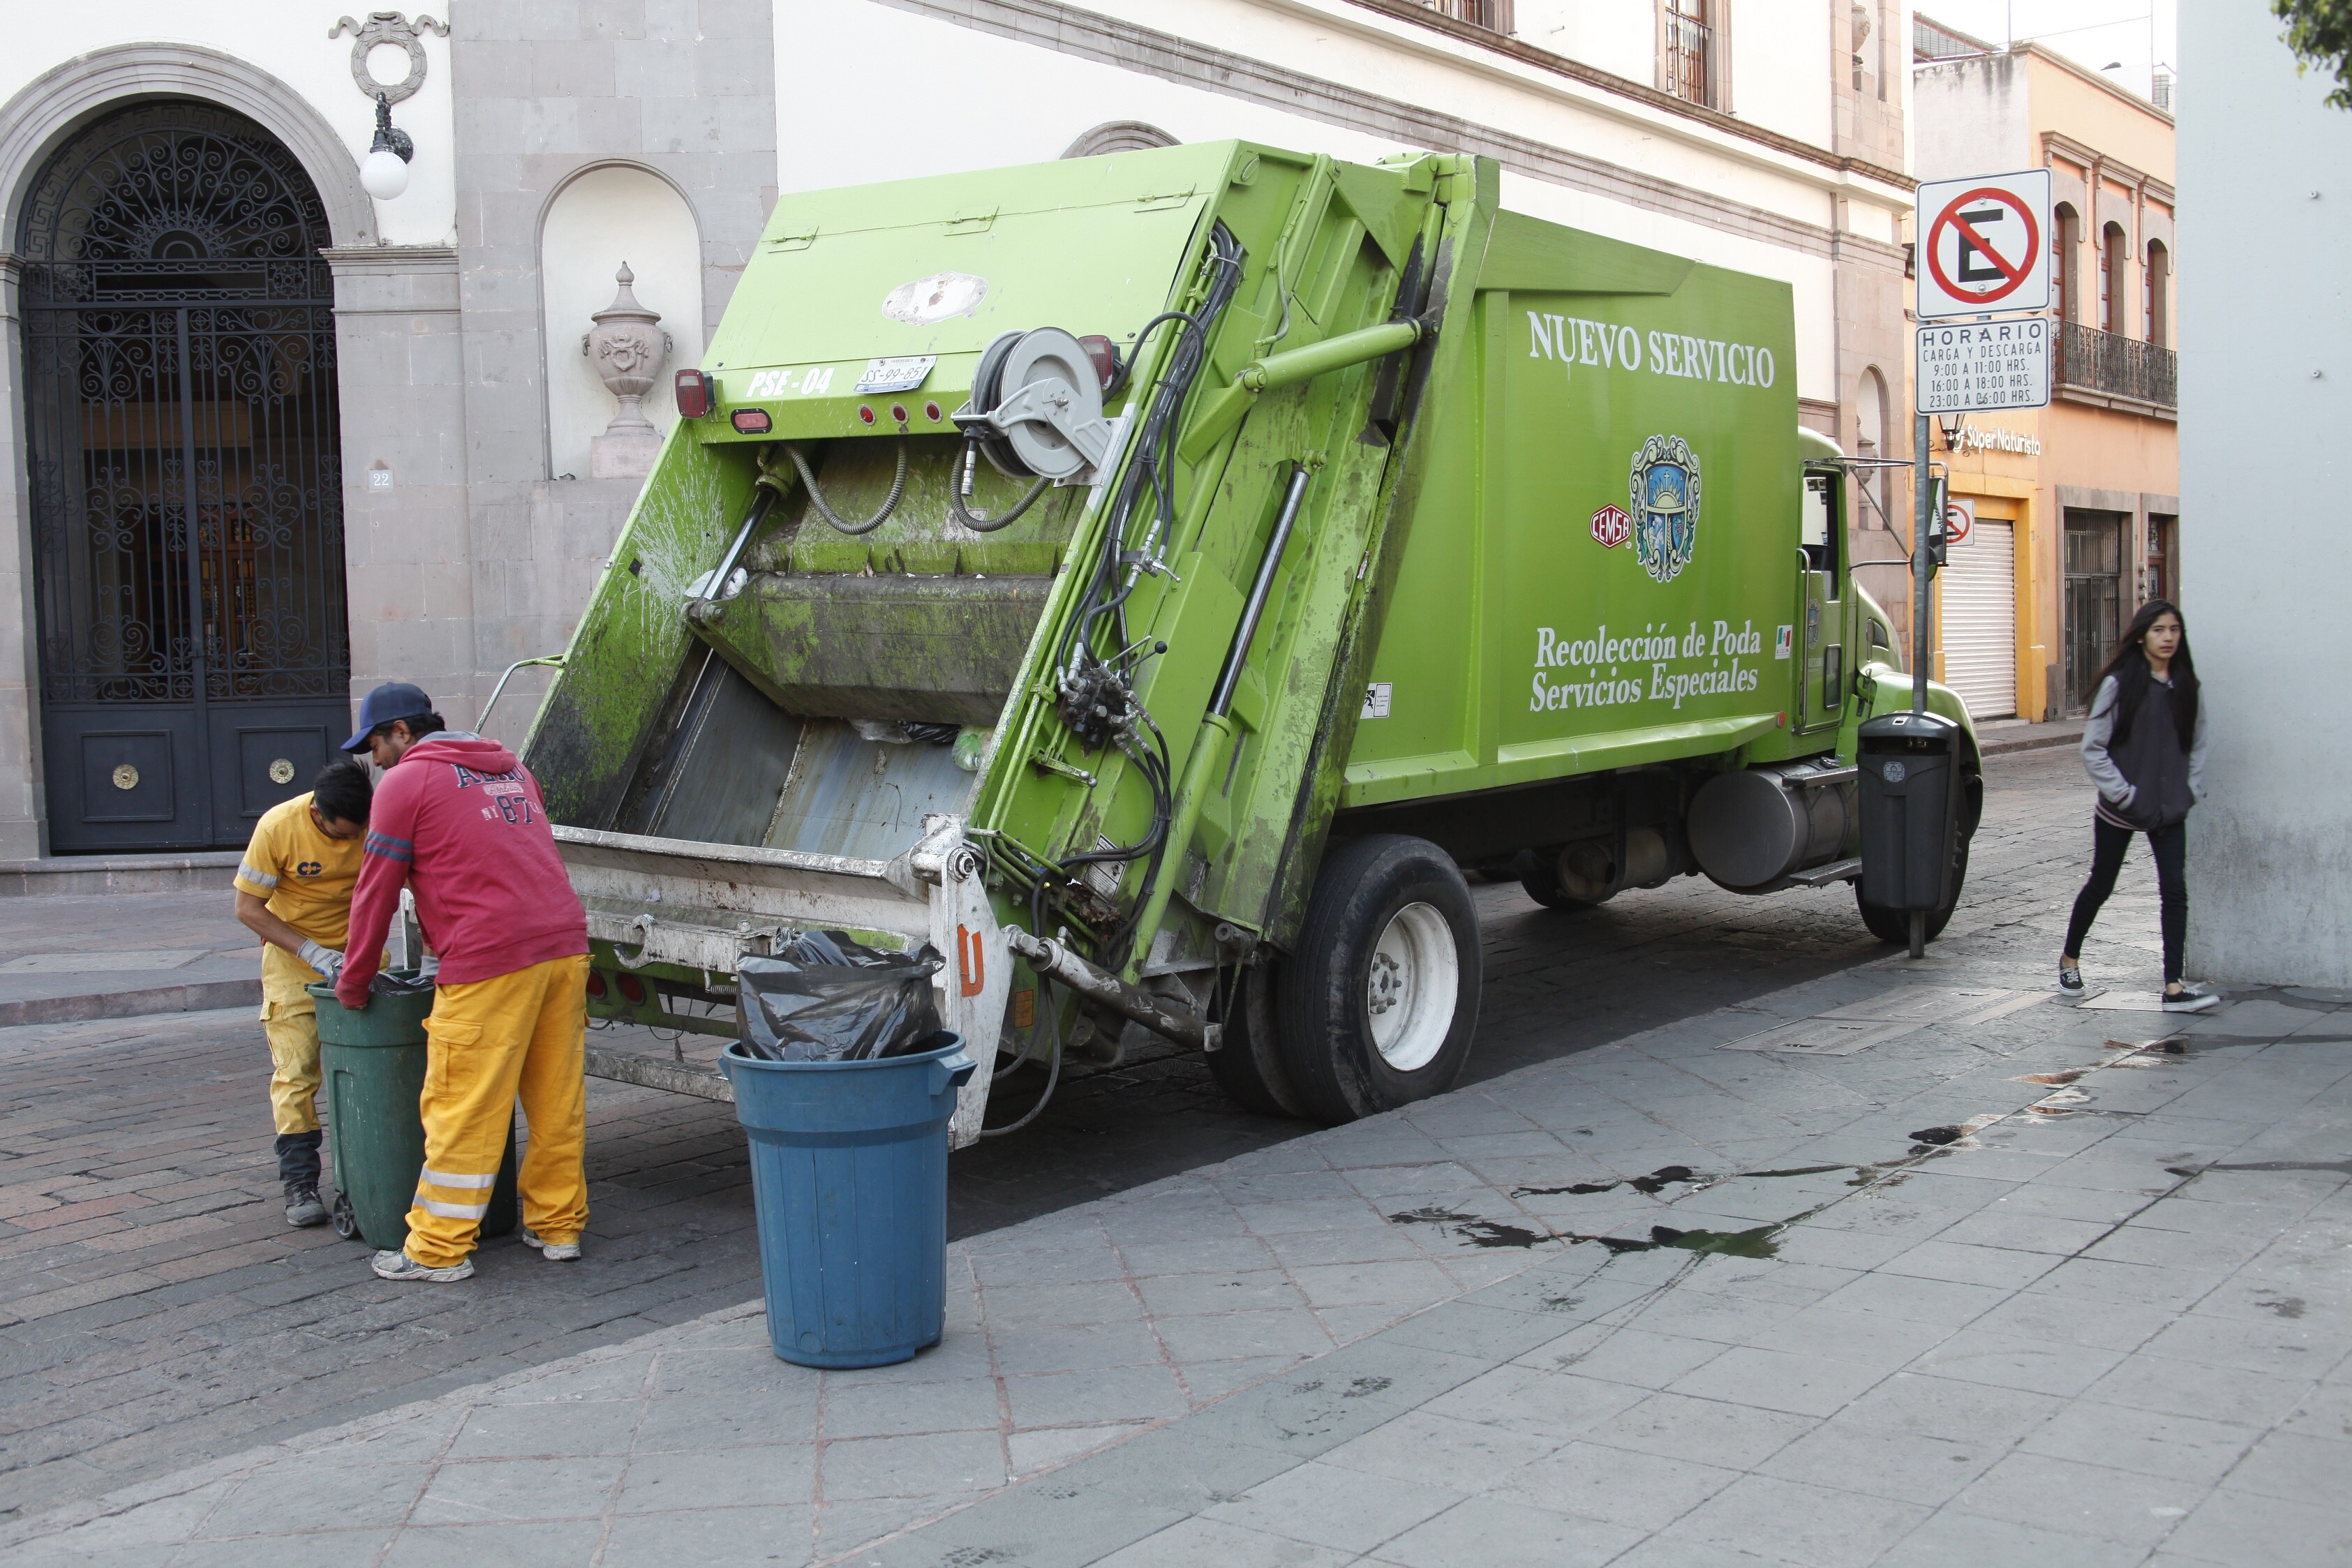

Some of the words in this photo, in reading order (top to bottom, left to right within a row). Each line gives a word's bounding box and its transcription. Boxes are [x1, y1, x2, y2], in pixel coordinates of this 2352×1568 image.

[1923, 323, 2041, 347] HORARIO
[1526, 311, 1641, 371] NUEVO
[1648, 330, 1775, 388] SERVICIO
[1923, 348, 1960, 362] CARGA
[1967, 347, 1973, 359] Y
[1981, 342, 2041, 358] DESCARGA
[861, 366, 928, 383] SS-99-851
[1934, 364, 1958, 377] 9:00
[1963, 362, 1969, 375] A
[1974, 360, 2001, 374] 11:00
[2007, 358, 2030, 372] HRS.
[1931, 378, 1958, 392] 16:00
[1964, 378, 1970, 390] A
[1977, 375, 2004, 389] 18:00
[2009, 373, 2032, 387] HRS.
[1930, 394, 1958, 408] 23:00
[1965, 393, 1970, 405] A
[1977, 391, 2006, 405] 06:00
[2011, 389, 2034, 403] HRS.
[1967, 424, 1996, 454] Súper
[1997, 427, 2041, 456] Naturista
[373, 473, 389, 486] 22
[1592, 510, 1630, 542] CEMSA
[1534, 622, 1676, 668] Recolección
[1682, 621, 1706, 658] de
[1710, 619, 1761, 656] Poda
[1529, 666, 1642, 712] Servicios
[1648, 658, 1758, 710] Especiales
[495, 794, 533, 824] 87
